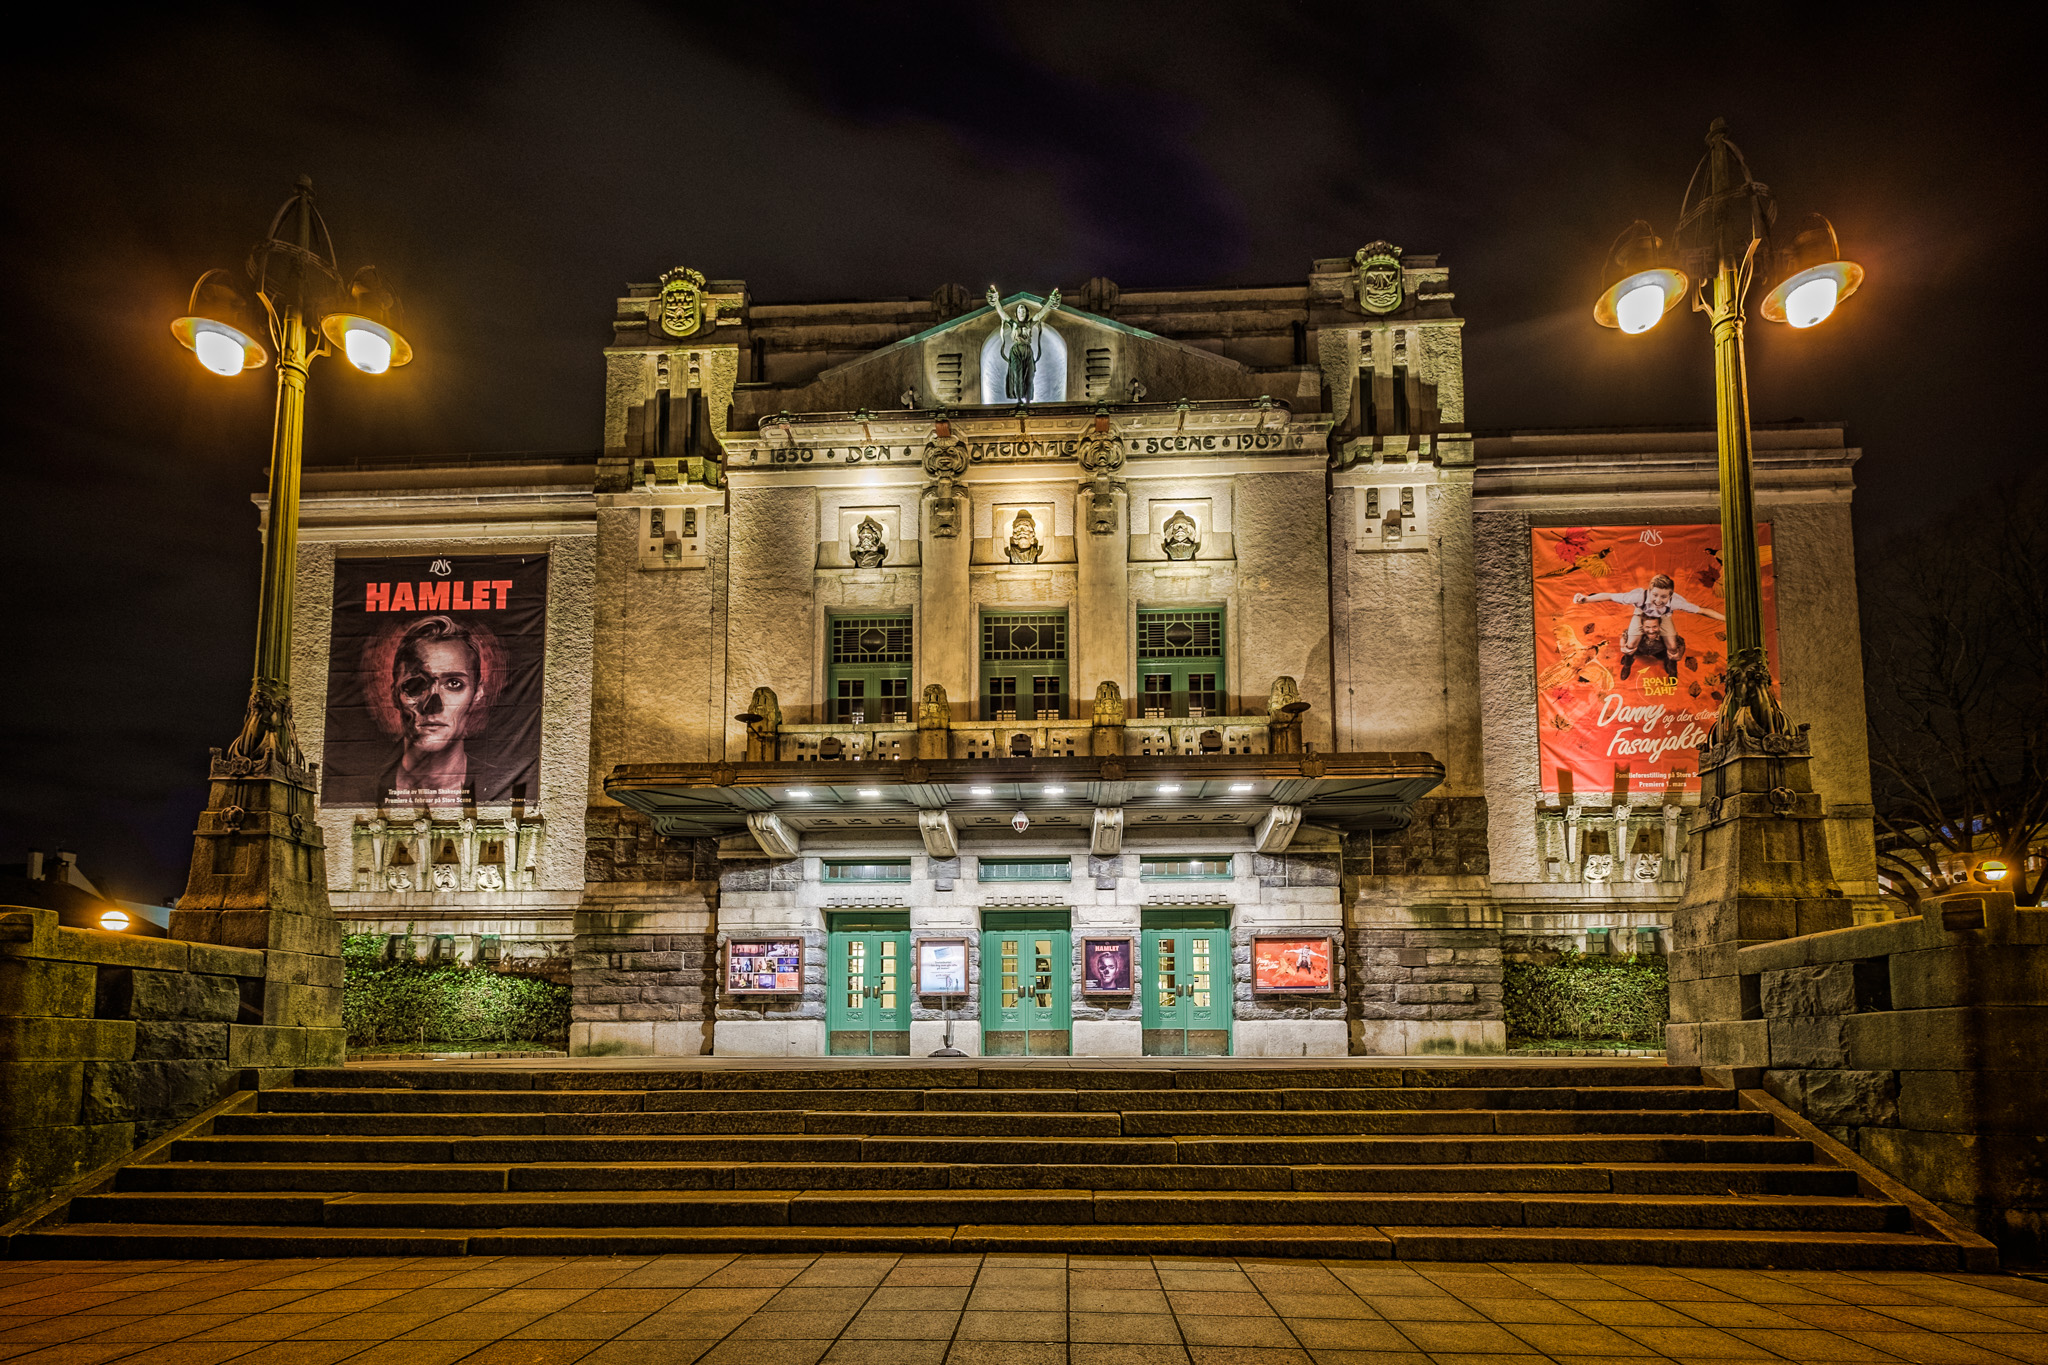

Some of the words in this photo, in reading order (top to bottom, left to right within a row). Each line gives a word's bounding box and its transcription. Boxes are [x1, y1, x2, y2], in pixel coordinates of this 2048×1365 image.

[770, 447, 814, 463] 1850
[845, 444, 891, 463] DEN
[971, 440, 1078, 461] NATIONALE
[1146, 435, 1216, 454] SCENE
[1236, 433, 1283, 450] 1909
[365, 580, 513, 612] HAMLET
[1643, 676, 1678, 686] ROALD
[1597, 693, 1666, 734] Danny
[1662, 714, 1675, 728] og
[1676, 708, 1695, 722] den
[1694, 709, 1719, 720] store
[1606, 722, 1707, 764] Fasanjakte
[388, 788, 410, 797] Tragedie
[438, 788, 470, 796] Shakespeare
[434, 797, 441, 805] på
